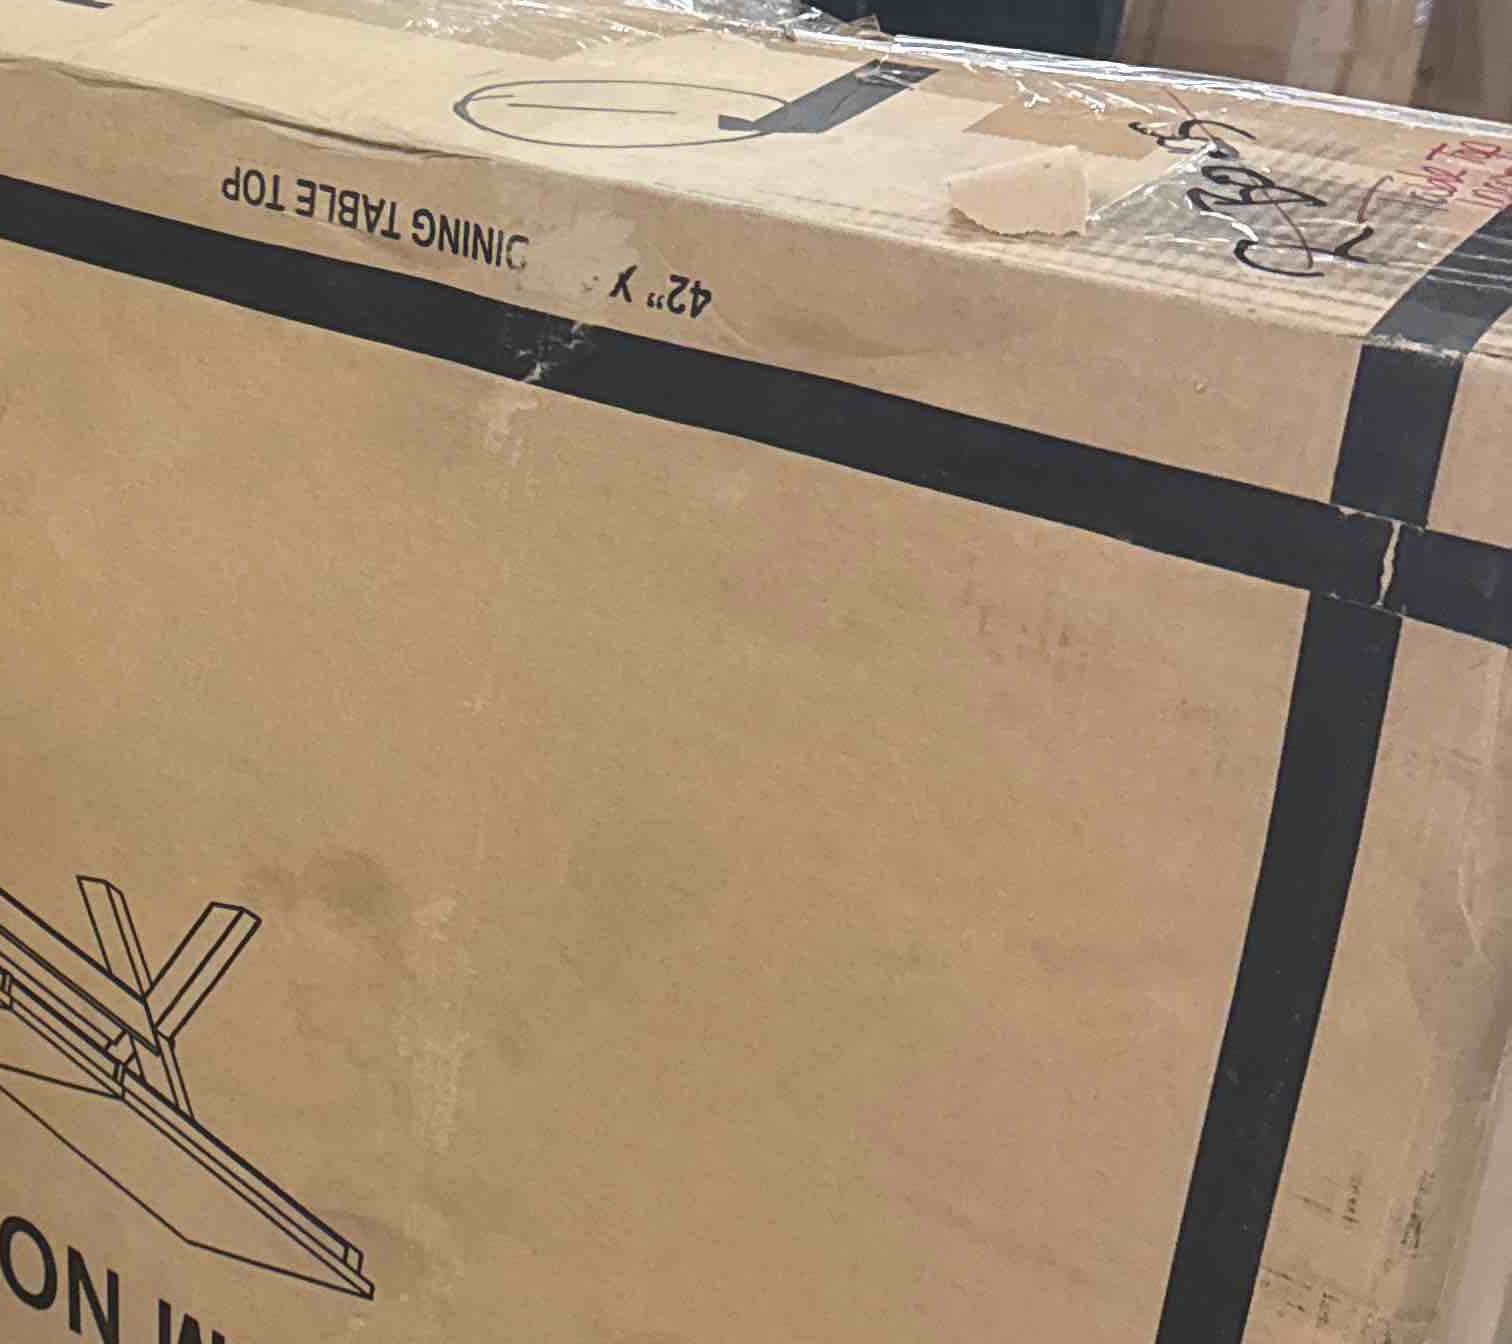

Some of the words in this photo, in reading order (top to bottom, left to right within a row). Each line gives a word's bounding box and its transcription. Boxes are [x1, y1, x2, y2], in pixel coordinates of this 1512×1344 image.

[221, 166, 285, 211] TOP
[295, 178, 401, 239] TABLE
[412, 223, 531, 272] DINING
